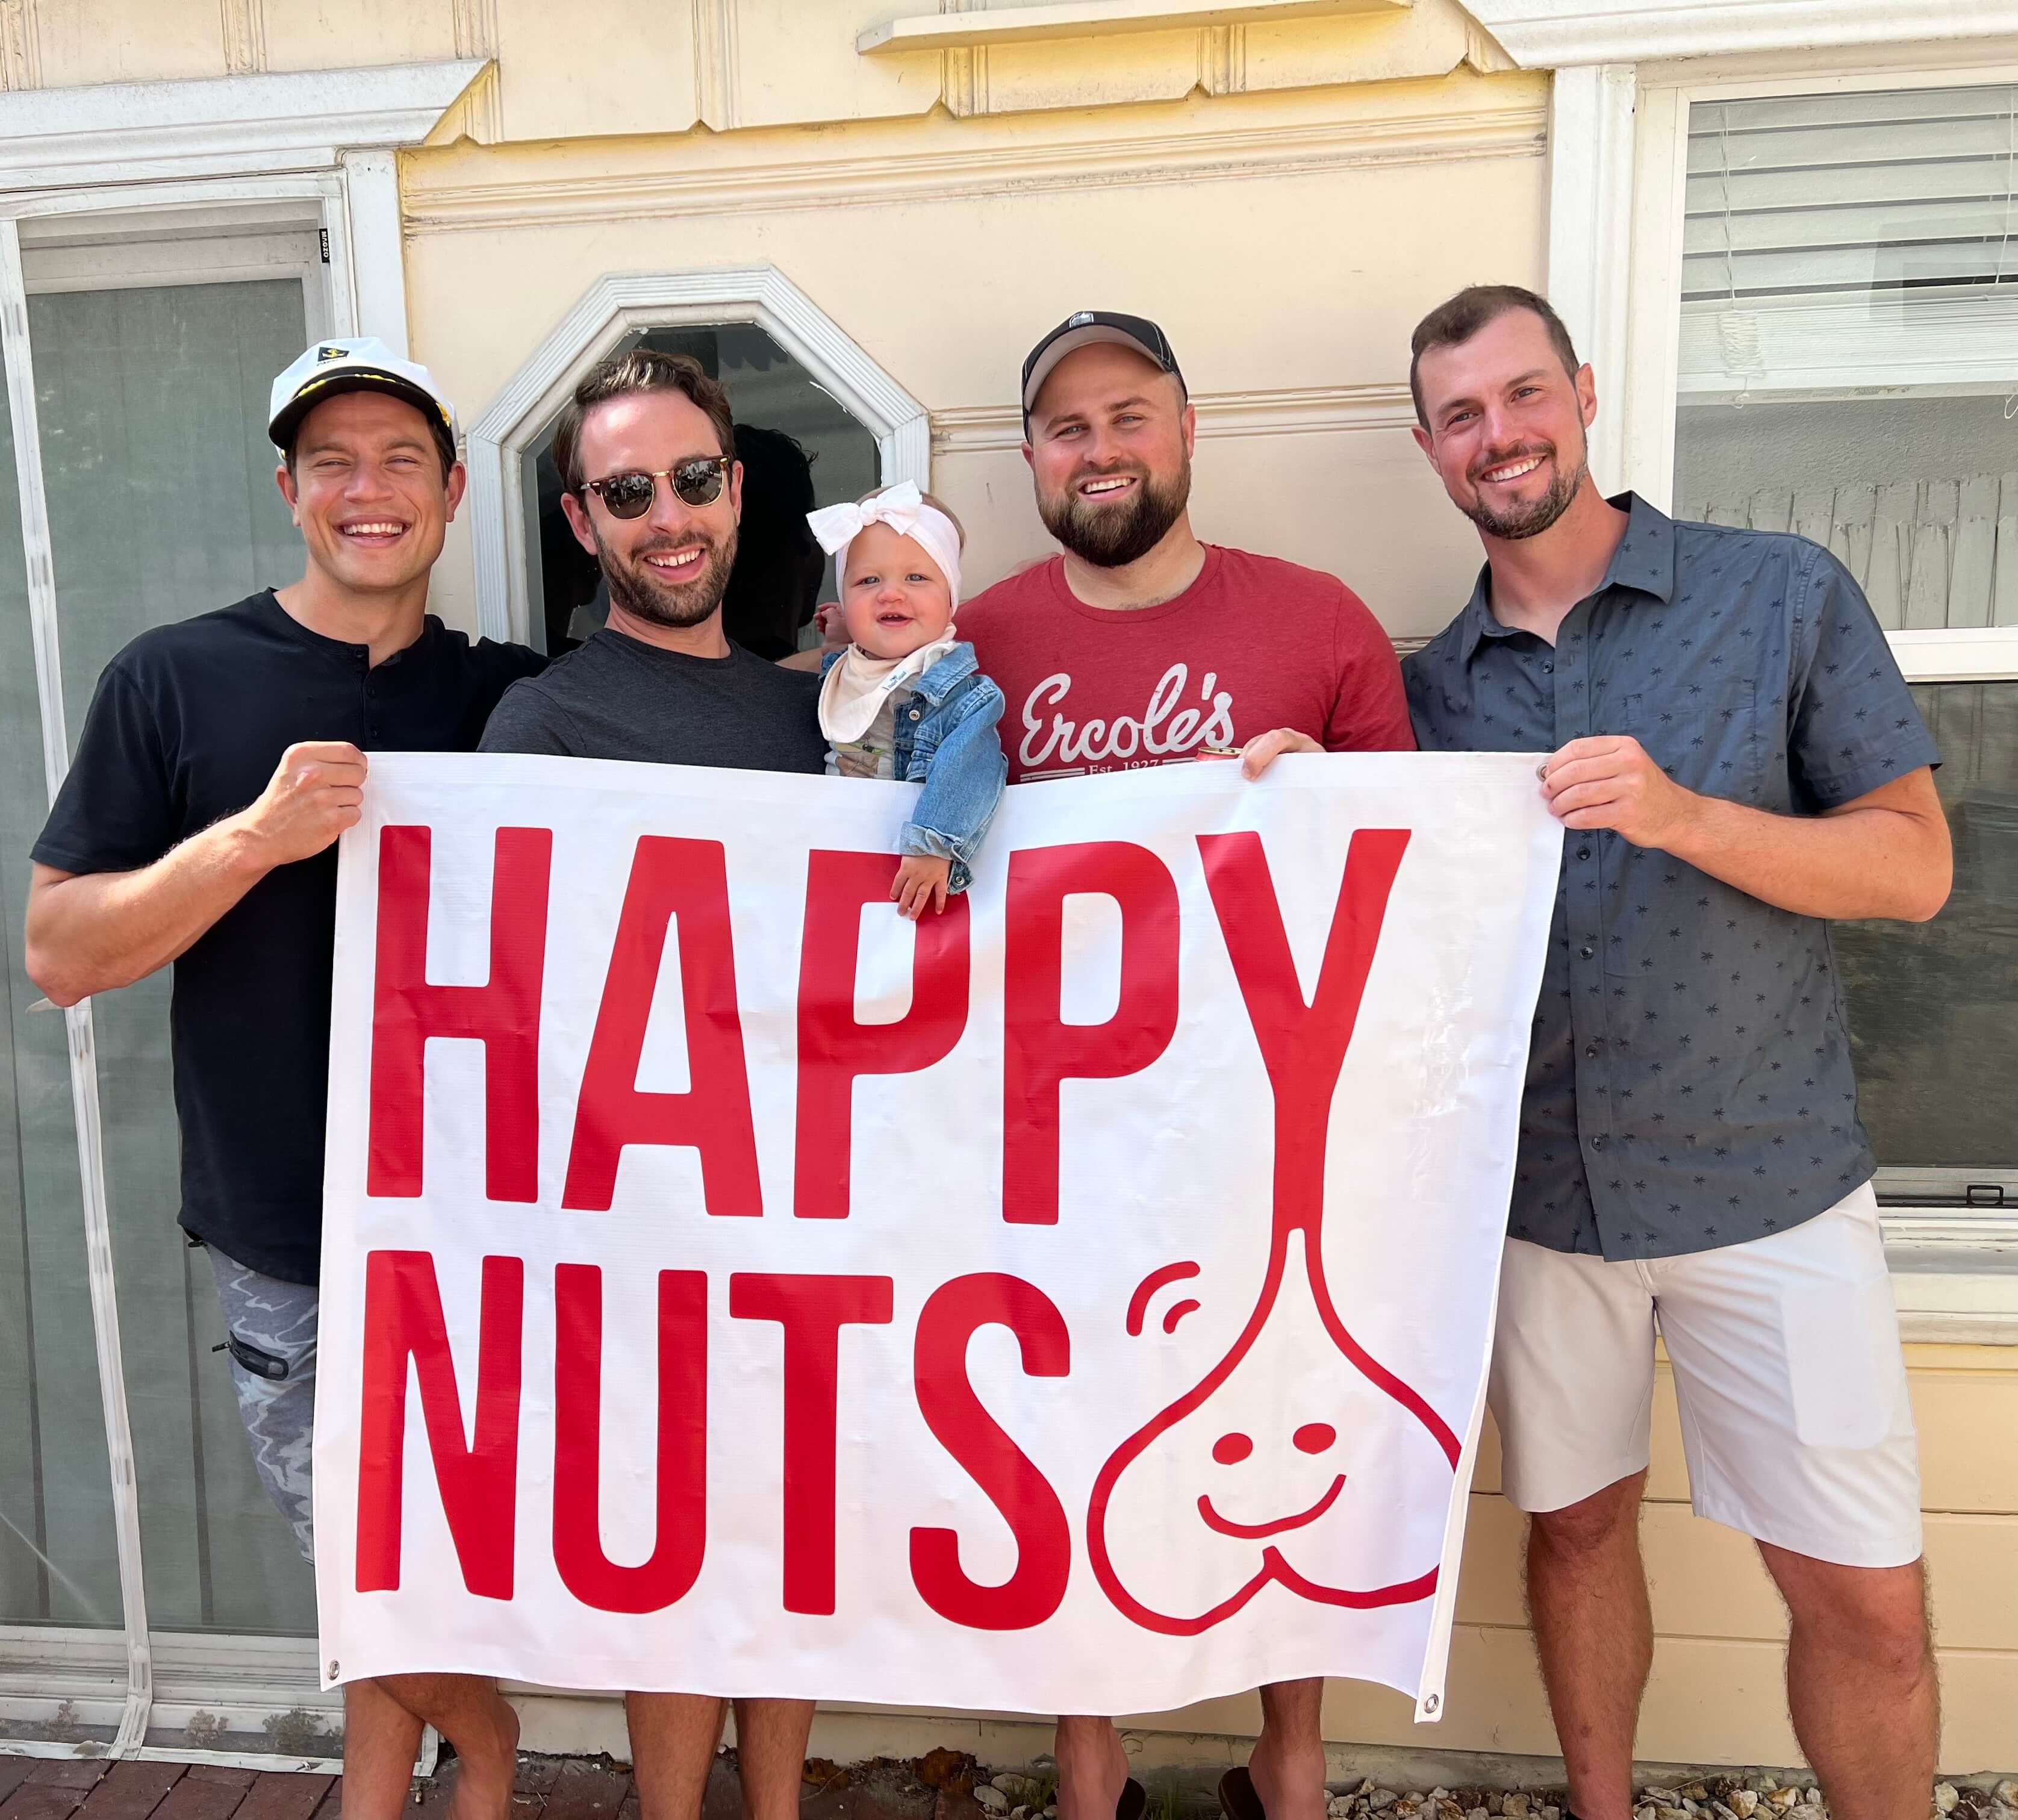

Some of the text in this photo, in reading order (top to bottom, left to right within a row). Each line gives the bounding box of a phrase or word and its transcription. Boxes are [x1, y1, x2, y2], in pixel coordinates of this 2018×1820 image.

[1019, 663, 1235, 767] Ercole's
[367, 826, 1412, 1226] HAPPY
[356, 1250, 1071, 1630] NUTS
